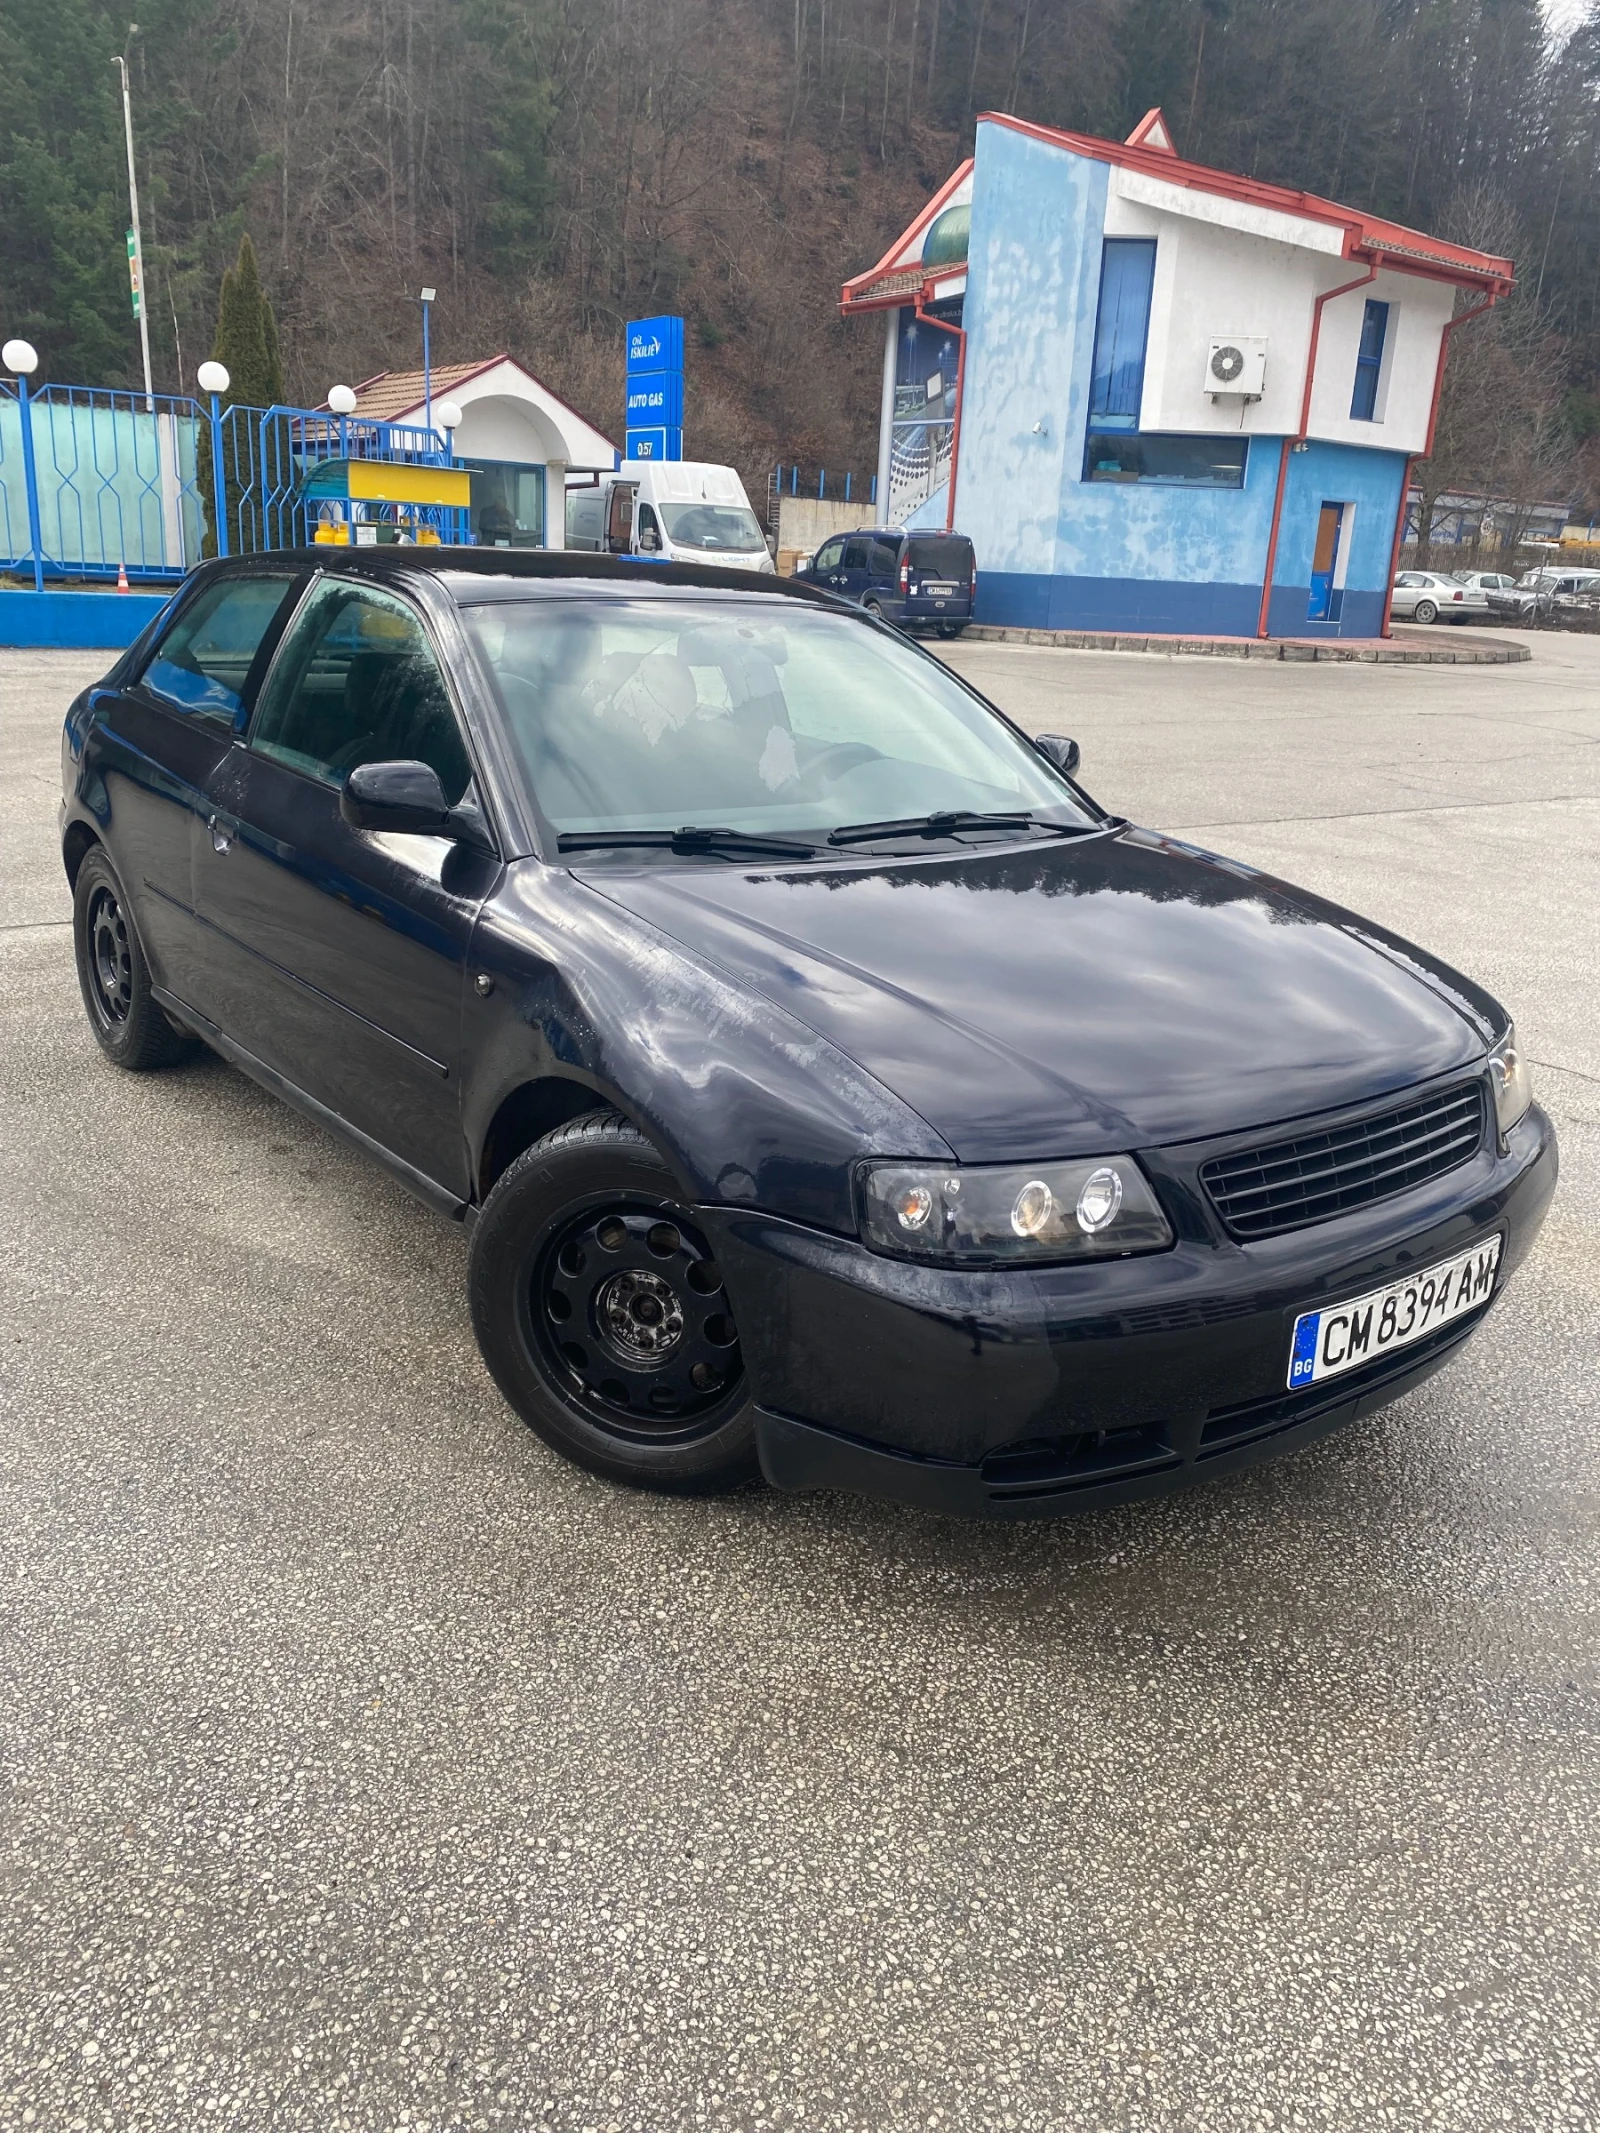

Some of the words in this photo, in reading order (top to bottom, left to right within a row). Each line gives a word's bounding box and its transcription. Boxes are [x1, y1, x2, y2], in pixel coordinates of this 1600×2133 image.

[630, 336, 661, 359] ISKILIEV
[628, 393, 647, 408] AUTO
[648, 392, 663, 406] GAS
[1322, 1305, 1373, 1367] CM
[1377, 1268, 1455, 1344] 8394
[1454, 1249, 1493, 1309] AM
[1293, 1358, 1313, 1377] BG
